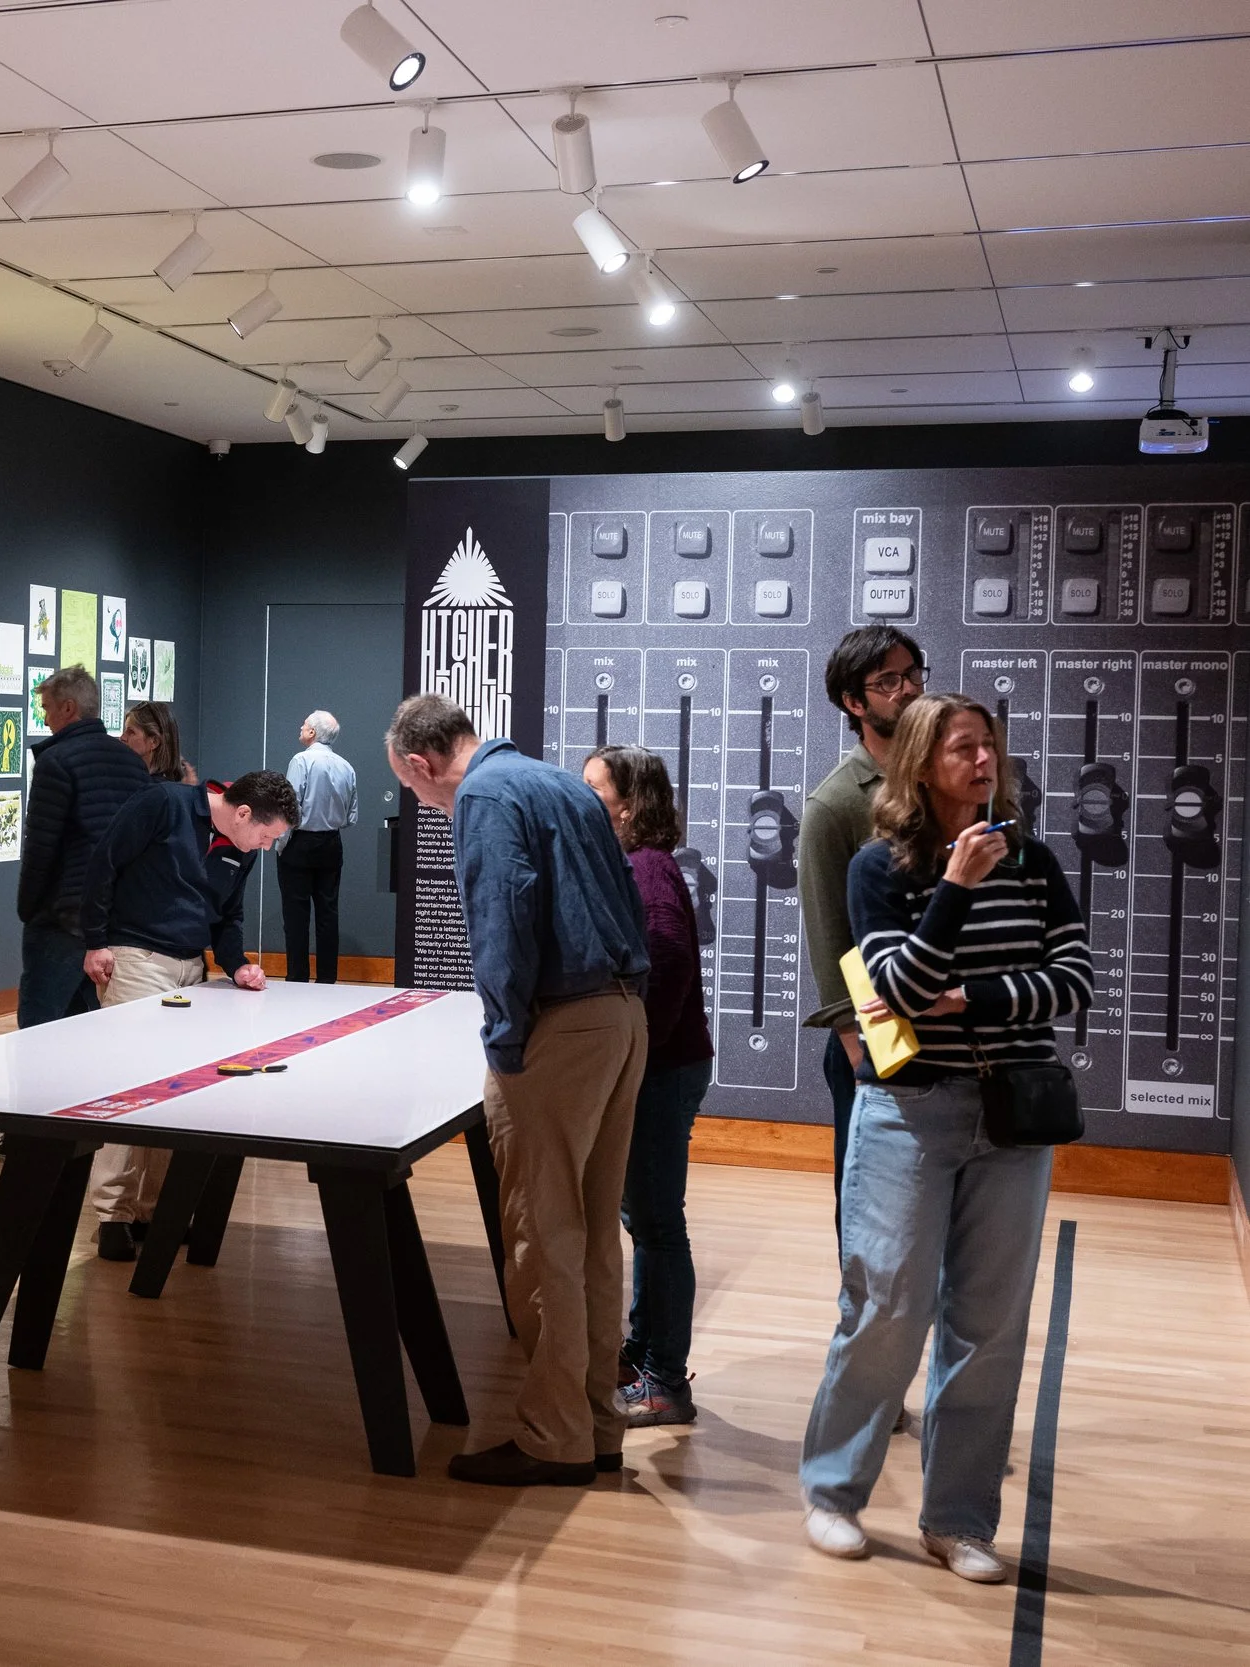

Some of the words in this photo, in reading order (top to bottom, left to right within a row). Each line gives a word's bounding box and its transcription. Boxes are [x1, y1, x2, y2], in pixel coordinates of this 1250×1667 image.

[862, 513, 886, 523] mix
[889, 512, 914, 525] bay
[683, 531, 702, 539] MUTE
[765, 531, 785, 539] MUTE
[983, 528, 1004, 536] MUTE
[1072, 528, 1094, 536] MUTE
[1163, 527, 1185, 535] MUTE
[599, 532, 618, 540] MUTE
[878, 547, 899, 558] VCA
[597, 591, 616, 599] SOLO
[681, 591, 700, 599] SOLO
[763, 591, 782, 599] SOLO
[870, 589, 906, 599] OUTPUT
[982, 590, 1002, 598] SOLO
[1163, 589, 1184, 597] SOLO
[420, 609, 514, 706] HIGHER
[594, 657, 615, 666] mix
[676, 657, 697, 667] mix
[758, 657, 779, 667] mix
[971, 659, 1014, 669] master
[1017, 658, 1037, 669] left
[1055, 660, 1099, 669] master
[1102, 659, 1133, 671] right
[1142, 660, 1187, 670] master
[1190, 661, 1228, 670] mono
[548, 706, 559, 714] 10
[626, 706, 638, 715] 10
[709, 708, 722, 717] 10
[792, 709, 804, 718] 10
[1029, 711, 1042, 721] 10
[1119, 713, 1132, 722] 10
[1211, 714, 1225, 723] 10
[551, 742, 558, 750] 5
[713, 745, 720, 754] 5
[795, 746, 802, 755] 5
[1033, 750, 1040, 759] 5
[1123, 752, 1130, 761] 5
[1215, 754, 1223, 763] 5
[711, 782, 719, 790] 0
[794, 784, 801, 793] 0
[711, 819, 718, 828] 5
[1121, 830, 1128, 839] 5
[1213, 834, 1220, 843] 5
[705, 856, 717, 866] 10
[1113, 870, 1127, 879] 10
[1205, 873, 1219, 883] 10
[415, 885, 446, 894] Burlington
[438, 894, 459, 902] Higher
[784, 896, 798, 906] 20
[1110, 909, 1125, 919] 20
[1202, 913, 1217, 922] 20
[415, 916, 441, 924] Crothers
[445, 933, 466, 942] Design
[783, 934, 797, 944] 30
[414, 940, 442, 949] Solidarity
[782, 953, 796, 963] 40
[1109, 949, 1124, 958] 30
[1201, 953, 1216, 962] 30
[782, 972, 796, 981] 50
[1108, 968, 1123, 978] 40
[1200, 973, 1216, 982] 40
[782, 991, 795, 1000] 70
[1108, 988, 1123, 997] 50
[1200, 993, 1215, 1002] 50
[1107, 1008, 1122, 1017] 70
[1200, 1013, 1215, 1022] 70
[1130, 1091, 1184, 1105] selected
[1188, 1094, 1211, 1106] mix
